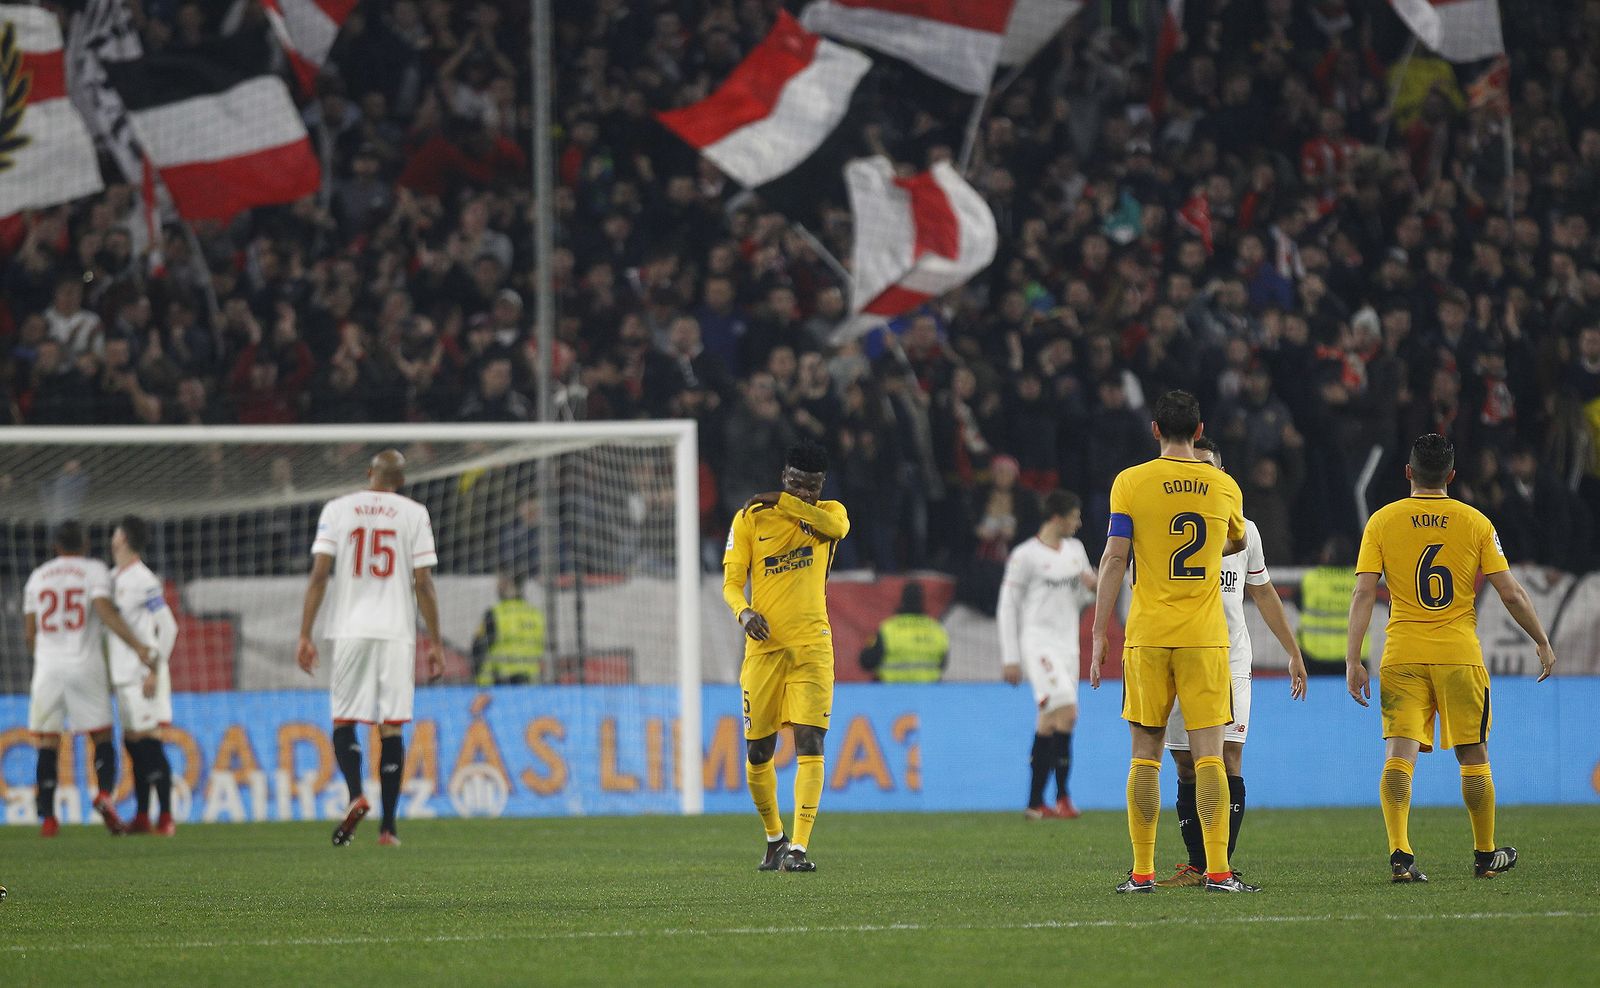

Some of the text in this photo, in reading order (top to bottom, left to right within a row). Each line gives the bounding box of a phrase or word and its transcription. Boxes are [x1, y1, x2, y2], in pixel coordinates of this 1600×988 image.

[1163, 478, 1209, 496] GODÍN
[1169, 512, 1206, 580] 2
[1411, 514, 1449, 529] KOKE
[348, 526, 397, 578] 15
[1415, 544, 1454, 611] 6
[39, 587, 86, 633] 25
[366, 693, 568, 796] MÁS
